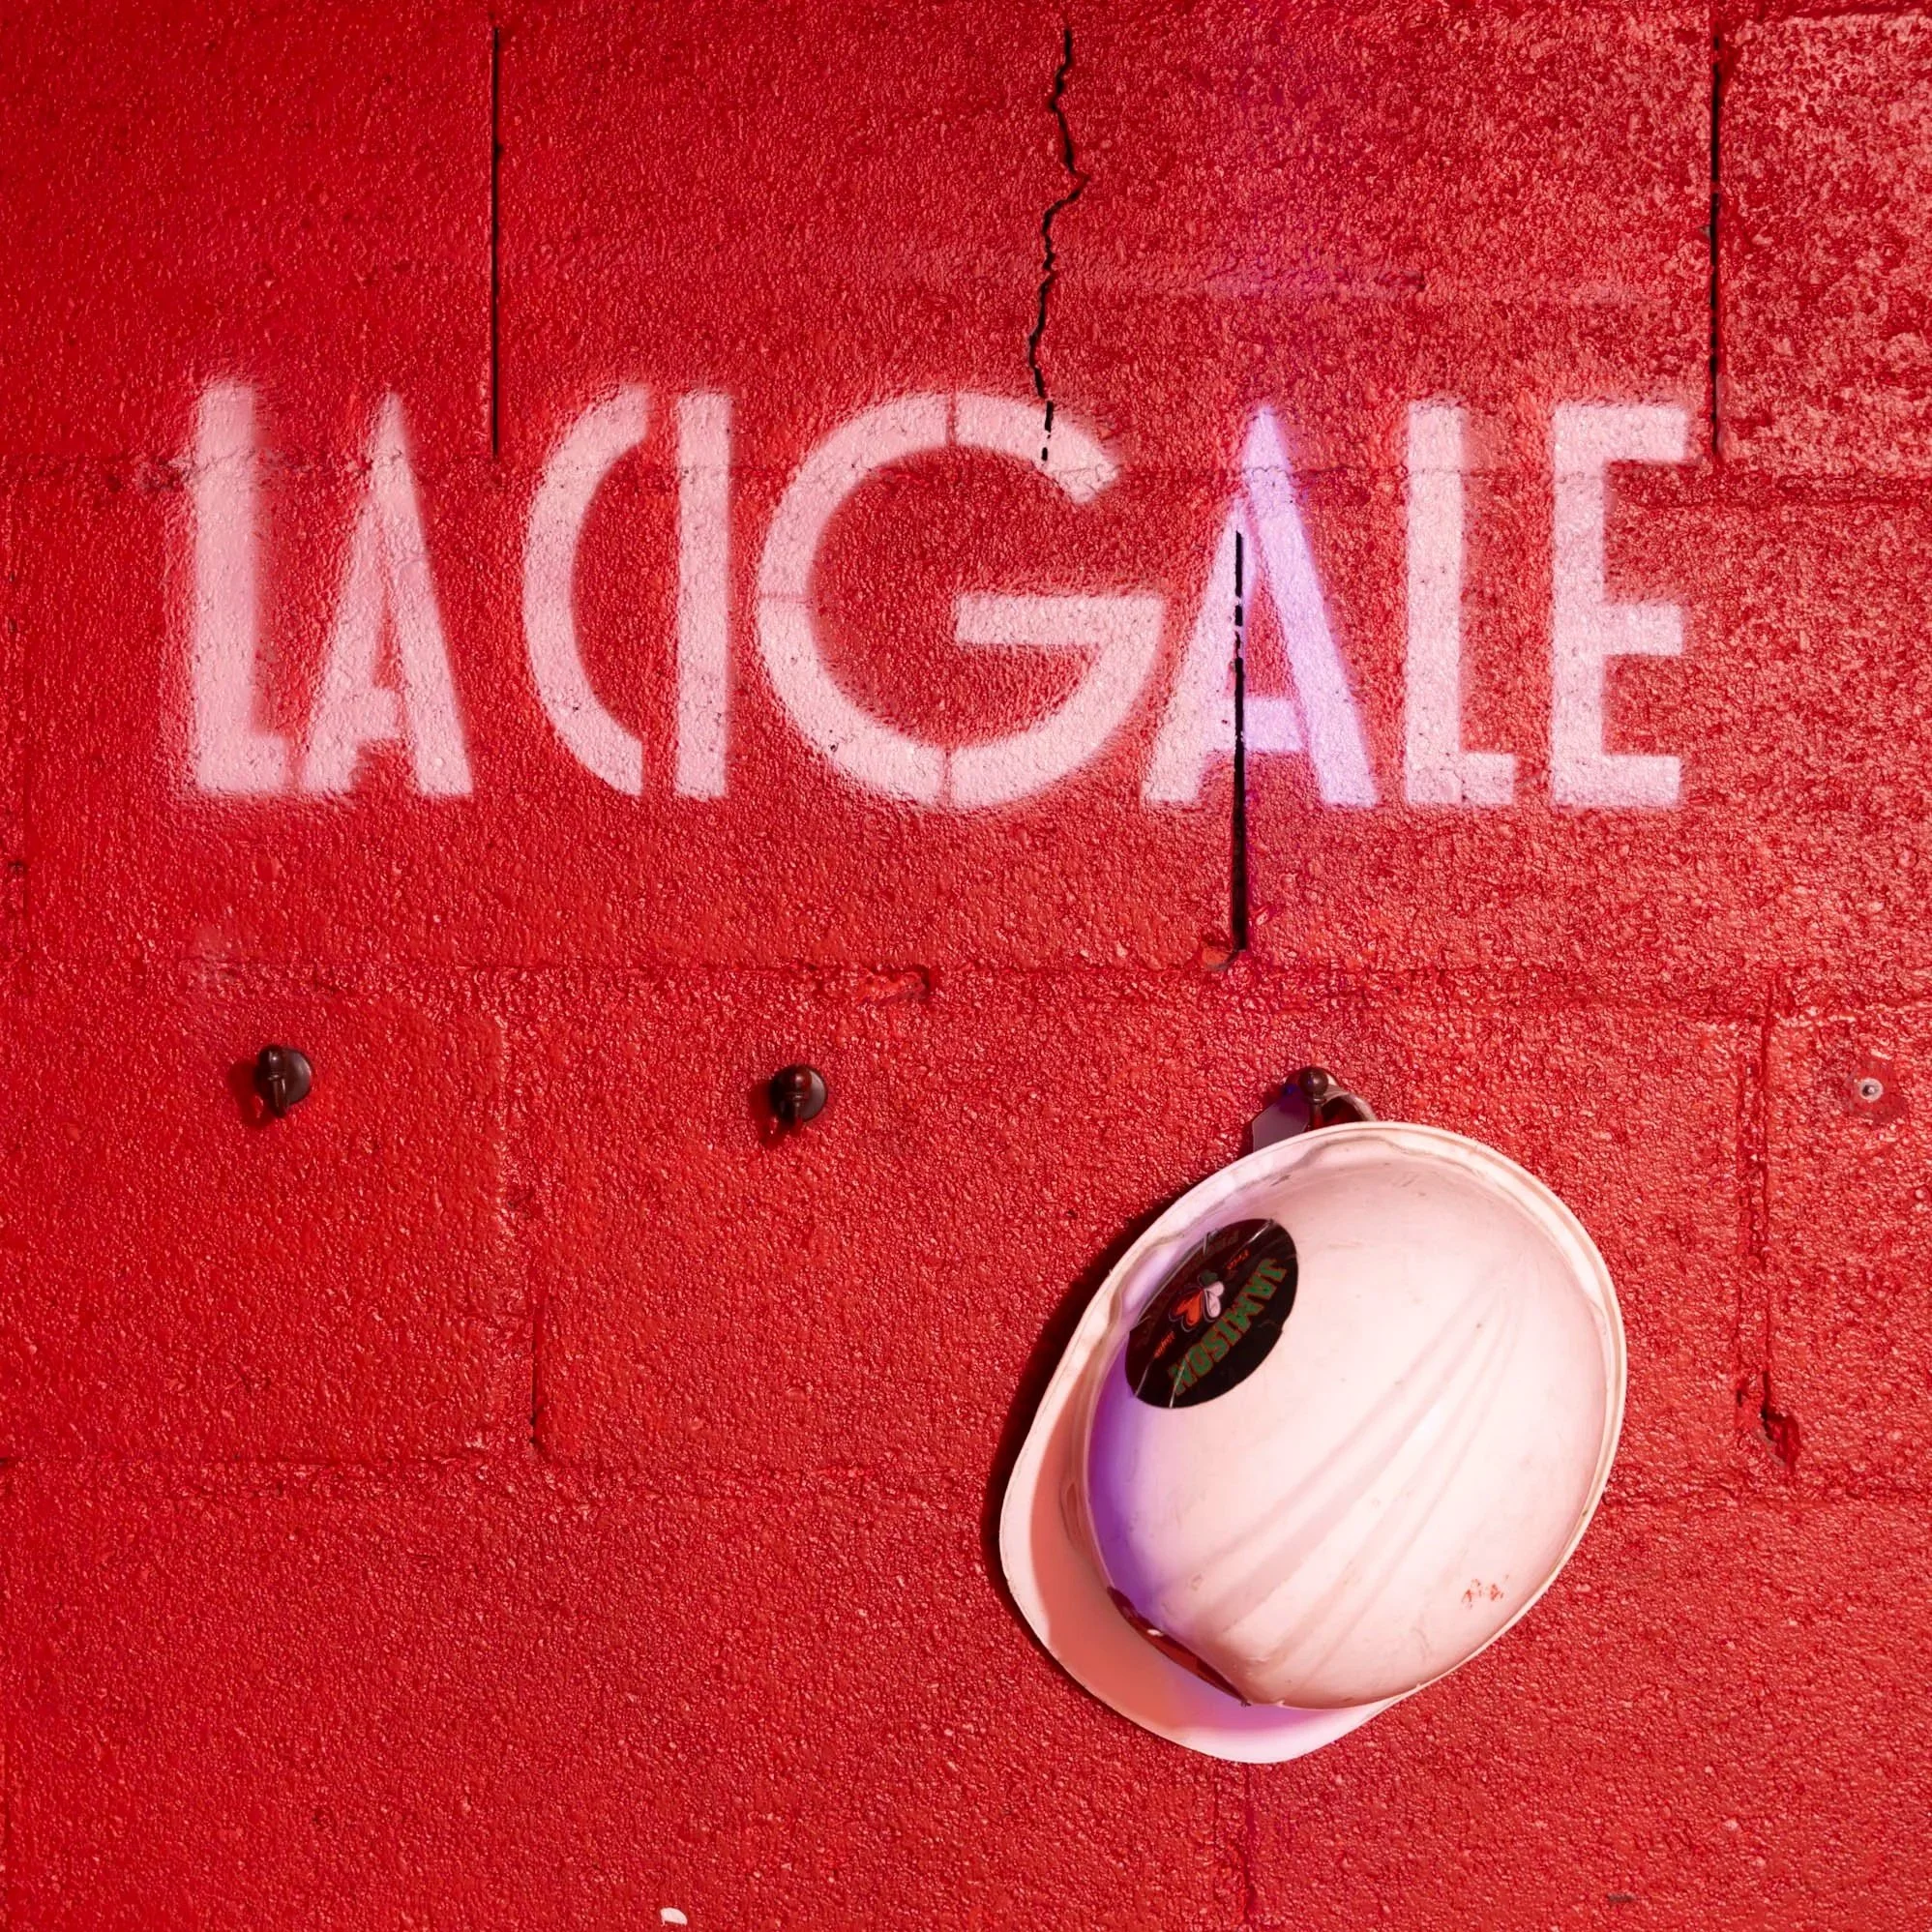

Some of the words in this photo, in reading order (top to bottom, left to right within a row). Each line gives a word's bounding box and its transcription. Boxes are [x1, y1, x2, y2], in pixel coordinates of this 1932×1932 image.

[193, 379, 474, 798] LA
[522, 385, 1688, 811] CIGALE
[1168, 1258, 1288, 1395] JAMISON
